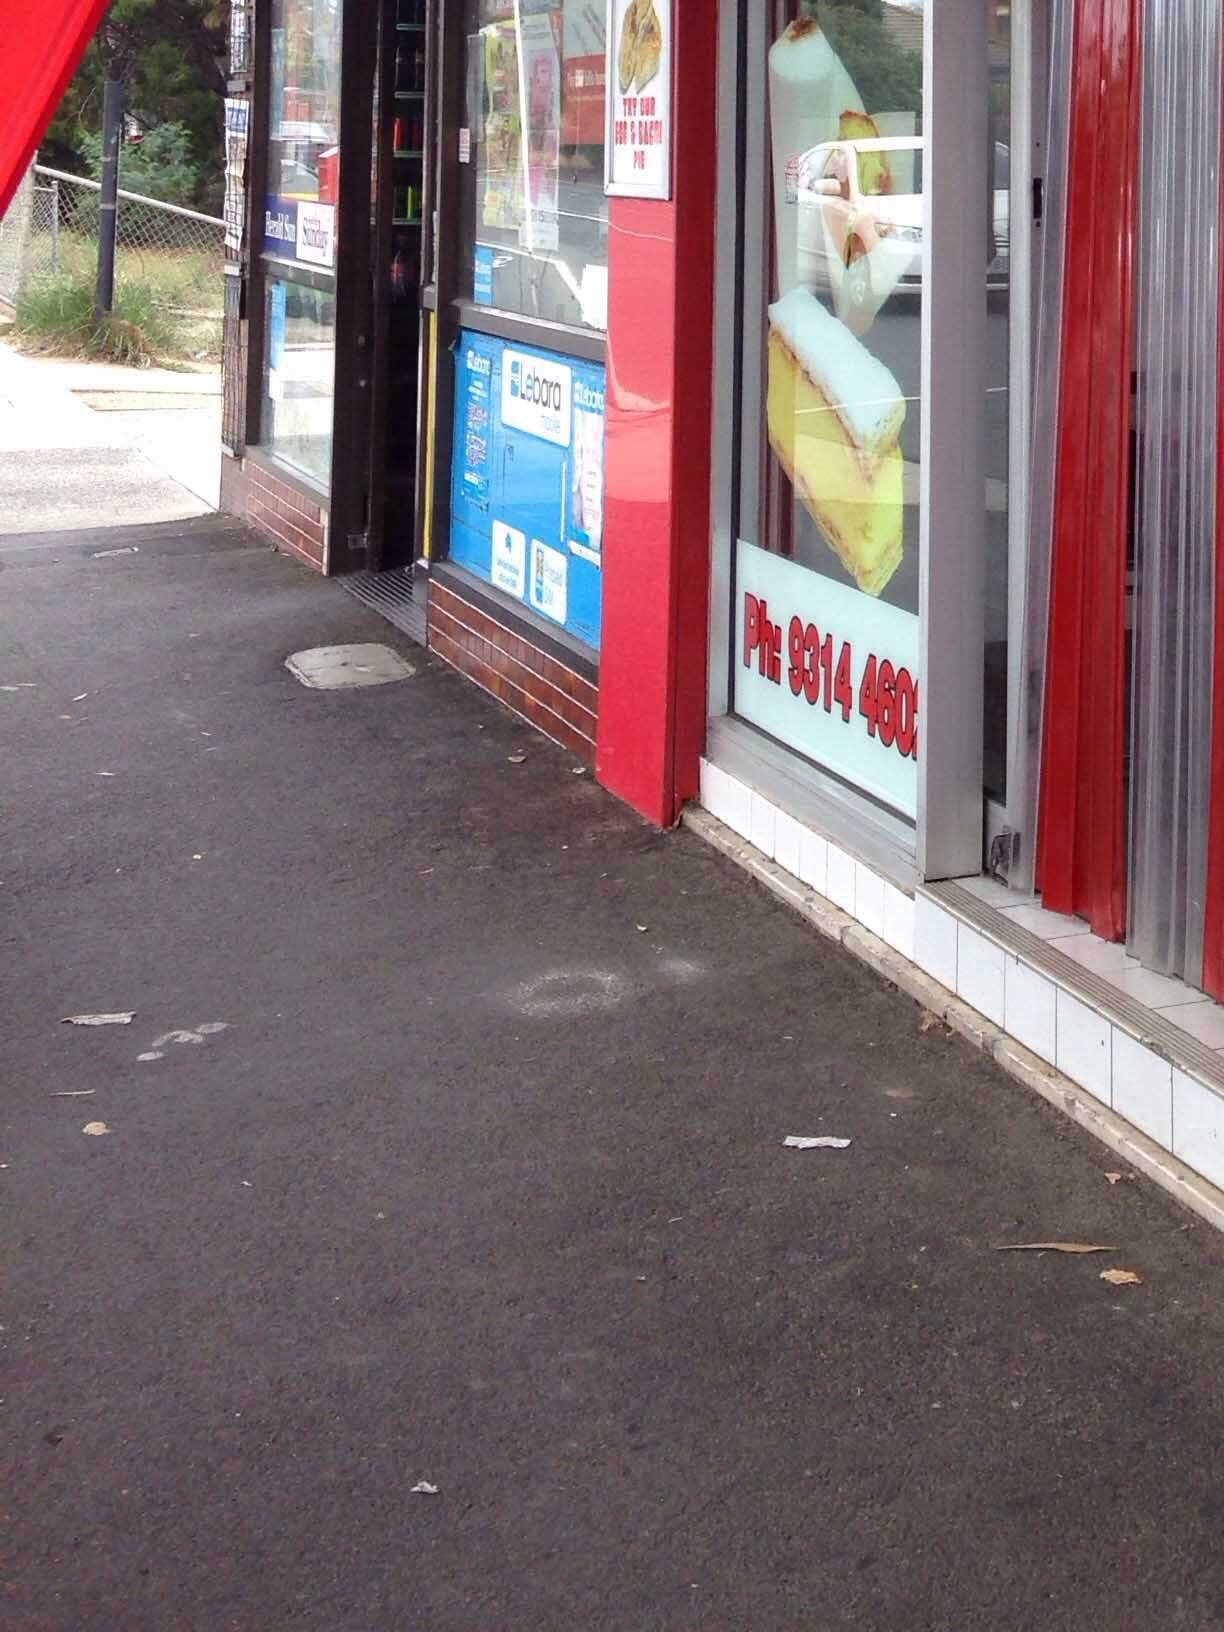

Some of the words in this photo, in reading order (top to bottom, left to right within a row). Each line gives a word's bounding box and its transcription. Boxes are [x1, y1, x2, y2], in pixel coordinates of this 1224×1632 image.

[520, 362, 562, 412] Lebara
[743, 592, 782, 686] Ph:
[788, 615, 853, 724] 9314
[858, 653, 919, 762] 460
